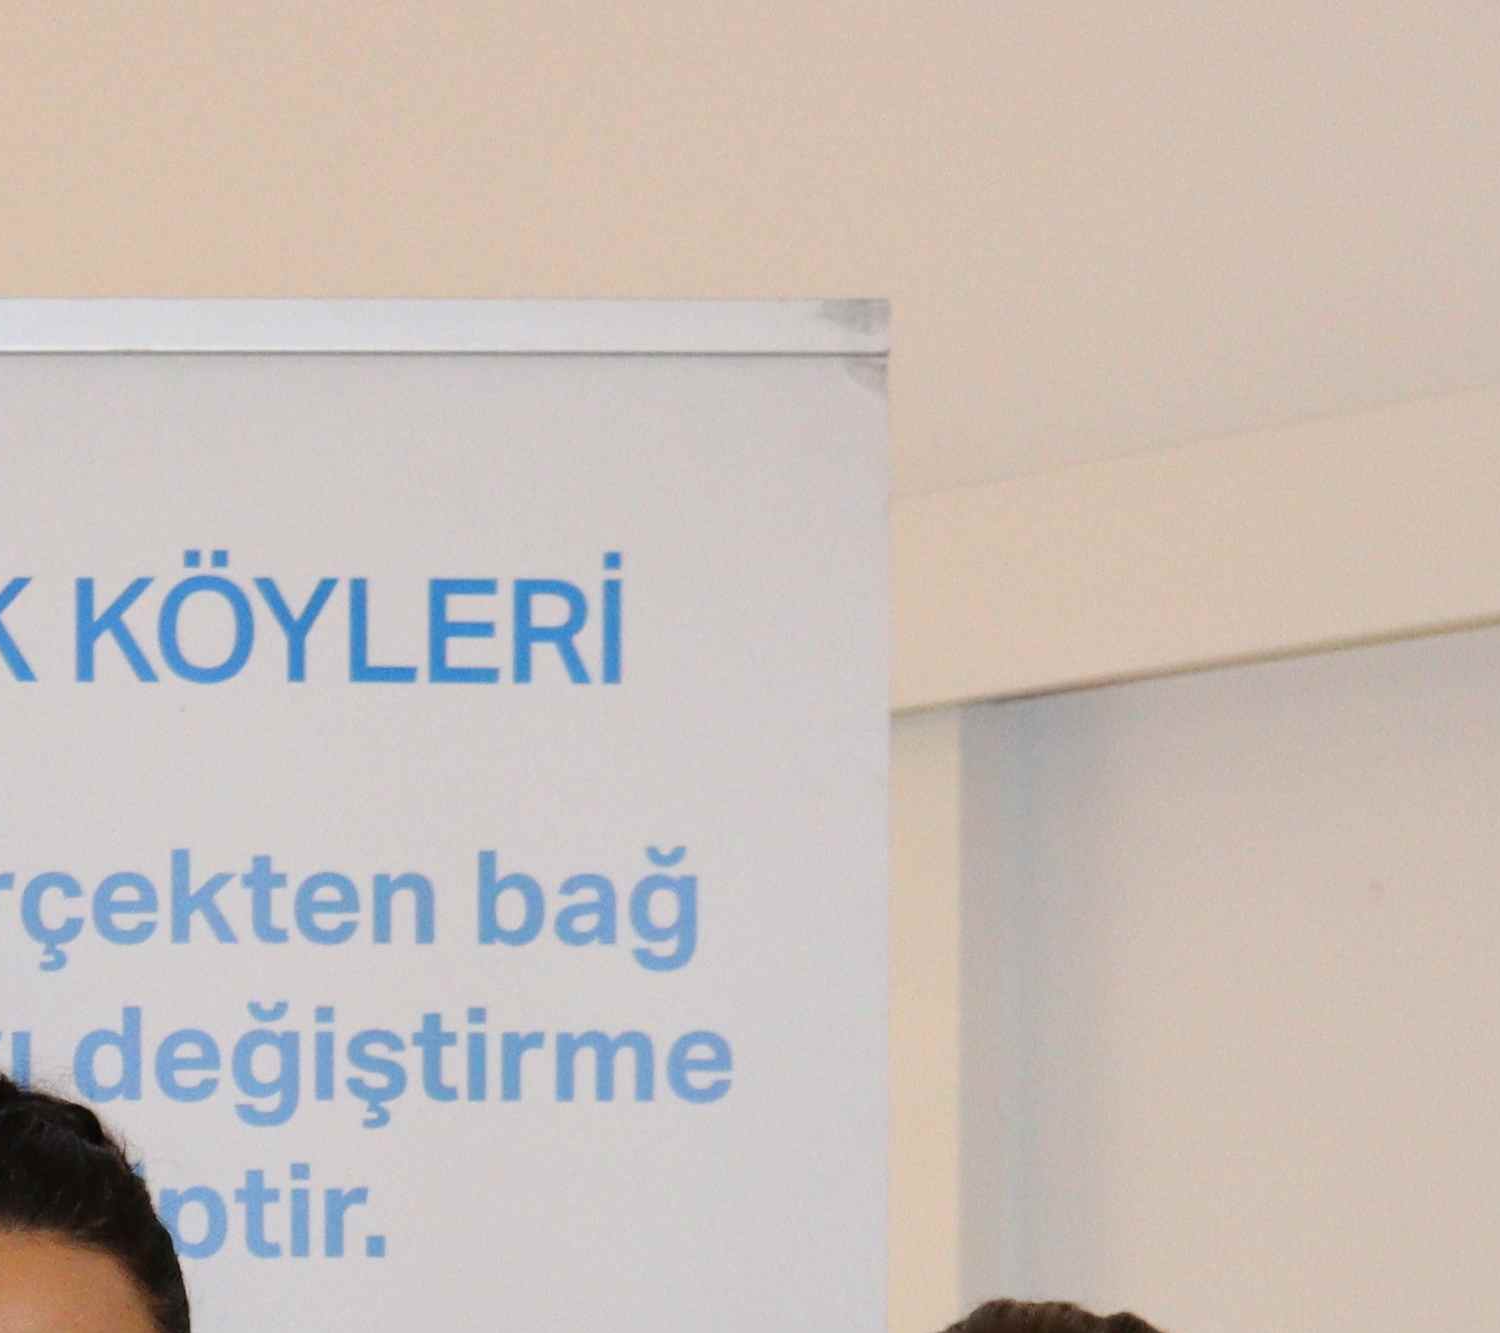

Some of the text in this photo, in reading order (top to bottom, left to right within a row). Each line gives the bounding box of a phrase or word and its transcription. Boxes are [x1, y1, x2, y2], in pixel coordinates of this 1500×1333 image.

[74, 547, 624, 687] KÖYLERİ
[477, 847, 698, 972] bağ
[72, 1000, 734, 1129] değiştirme
